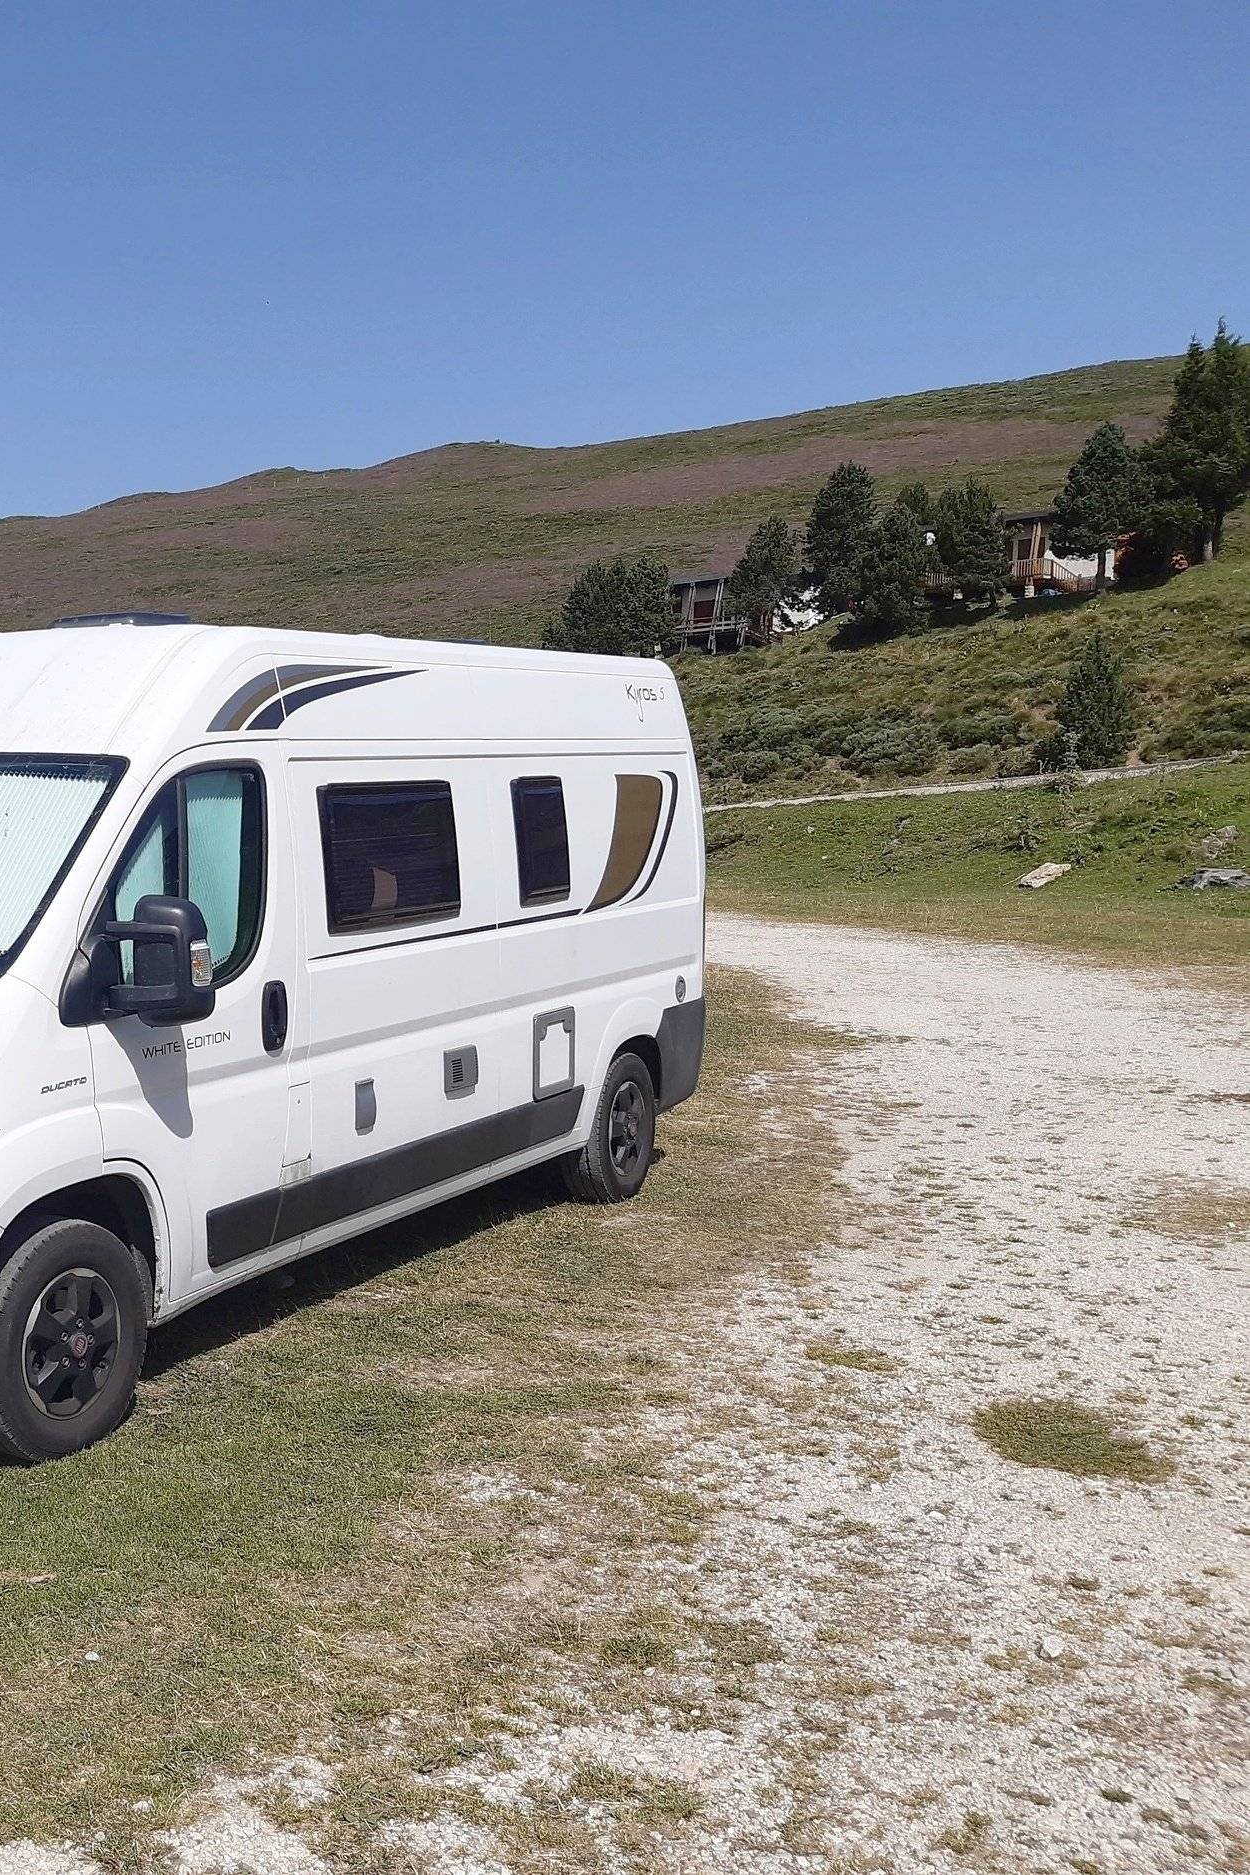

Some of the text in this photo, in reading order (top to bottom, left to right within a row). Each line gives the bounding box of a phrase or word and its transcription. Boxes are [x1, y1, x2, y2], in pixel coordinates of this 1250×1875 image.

[624, 683, 657, 722] Kyros
[142, 1031, 231, 1059] WHITE EDITION
[40, 1076, 87, 1094] DUCATO
